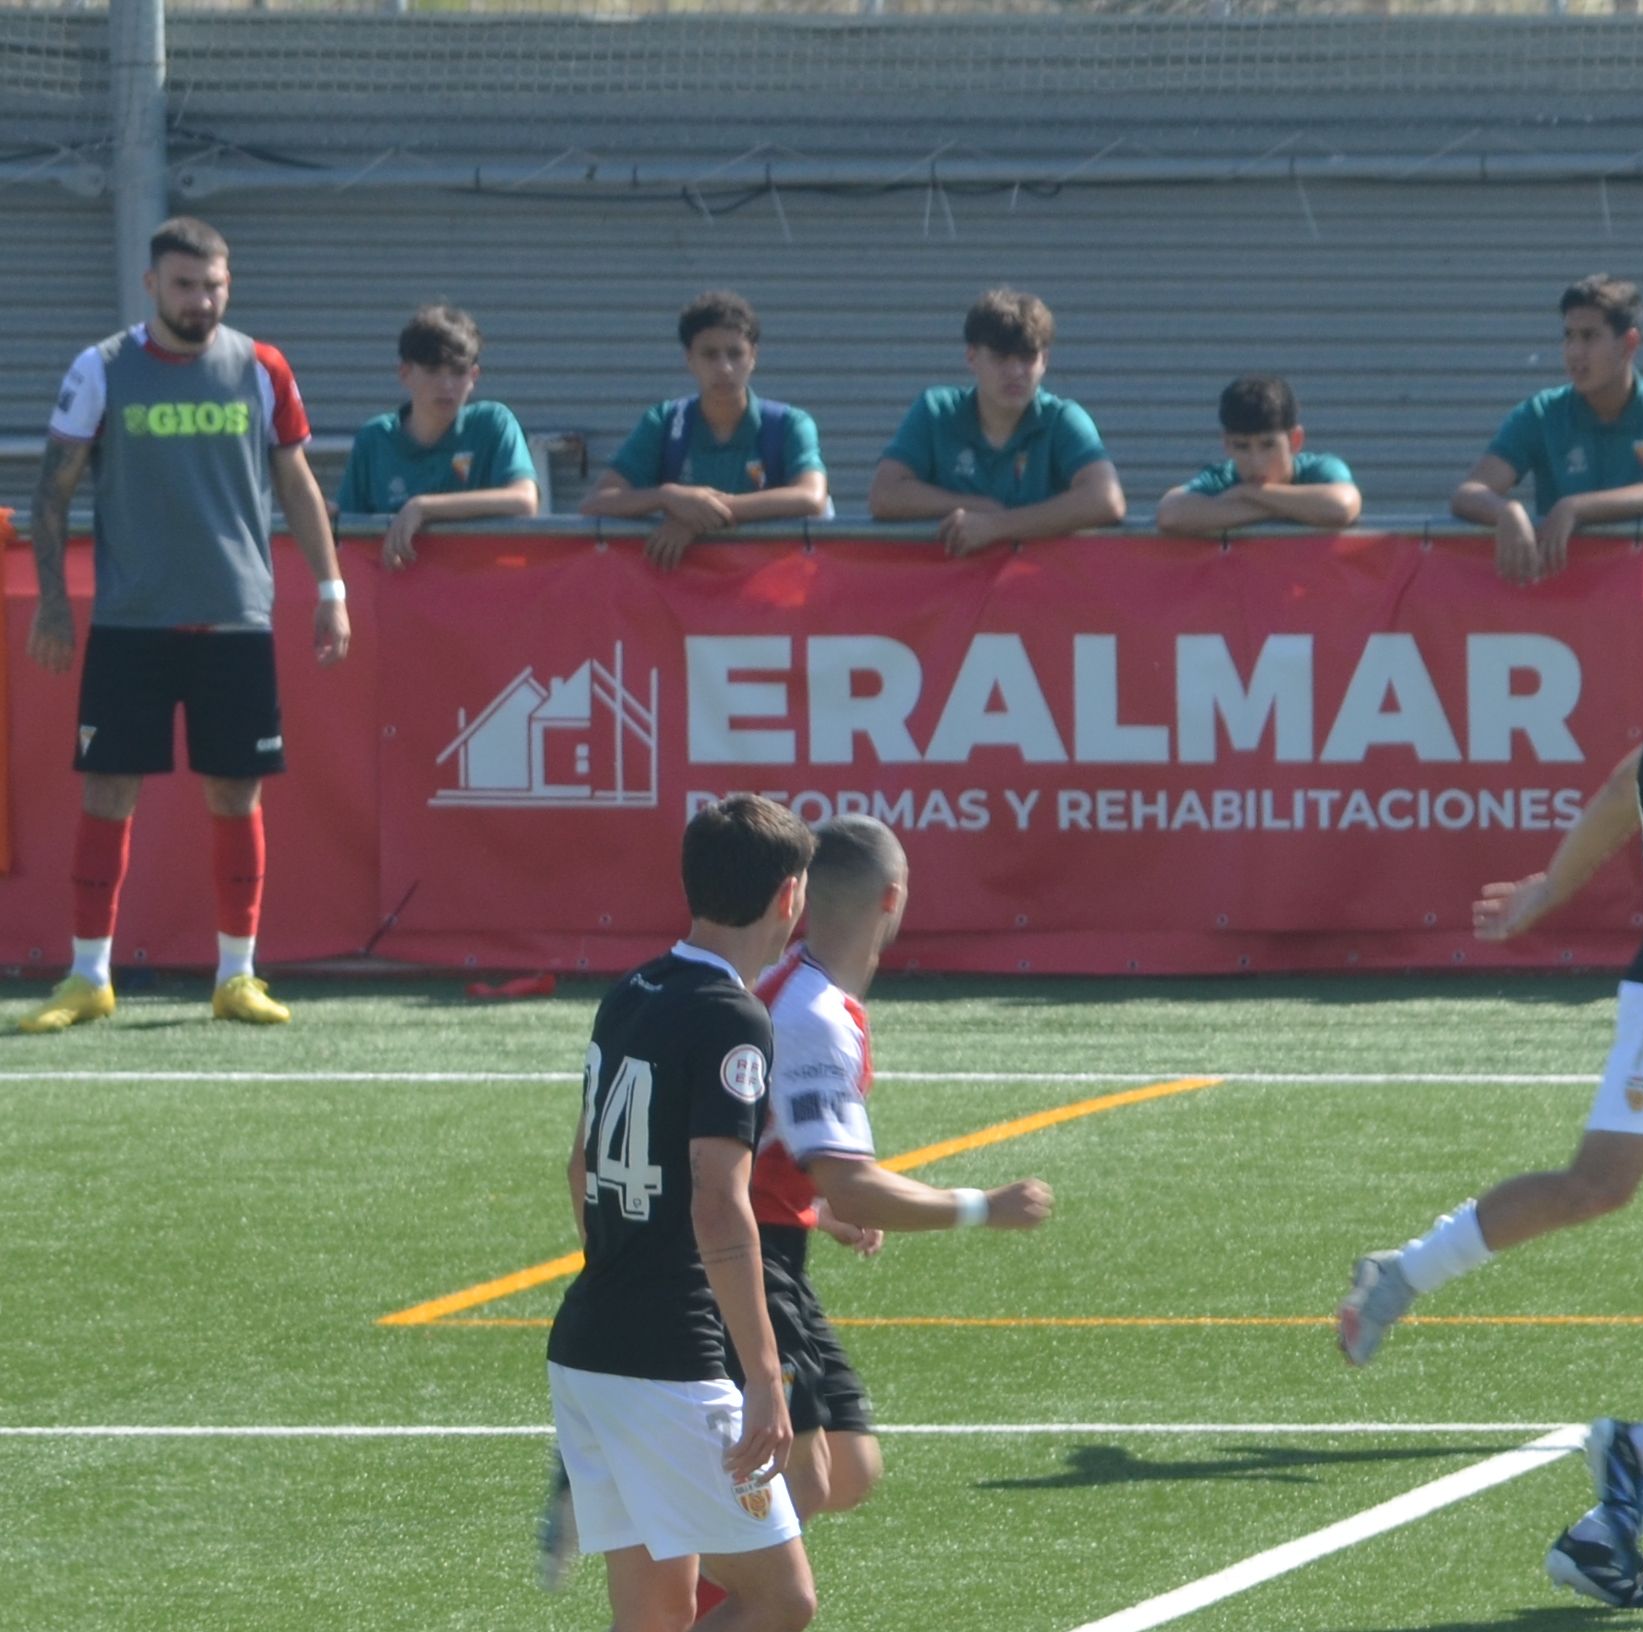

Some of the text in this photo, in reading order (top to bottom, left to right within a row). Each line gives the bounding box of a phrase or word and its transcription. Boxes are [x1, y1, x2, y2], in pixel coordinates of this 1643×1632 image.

[148, 402, 249, 437] GIOS
[684, 633, 1586, 764] ERALMAR
[1008, 789, 1041, 831] Y
[1057, 788, 1584, 832] REHABILITACIONES
